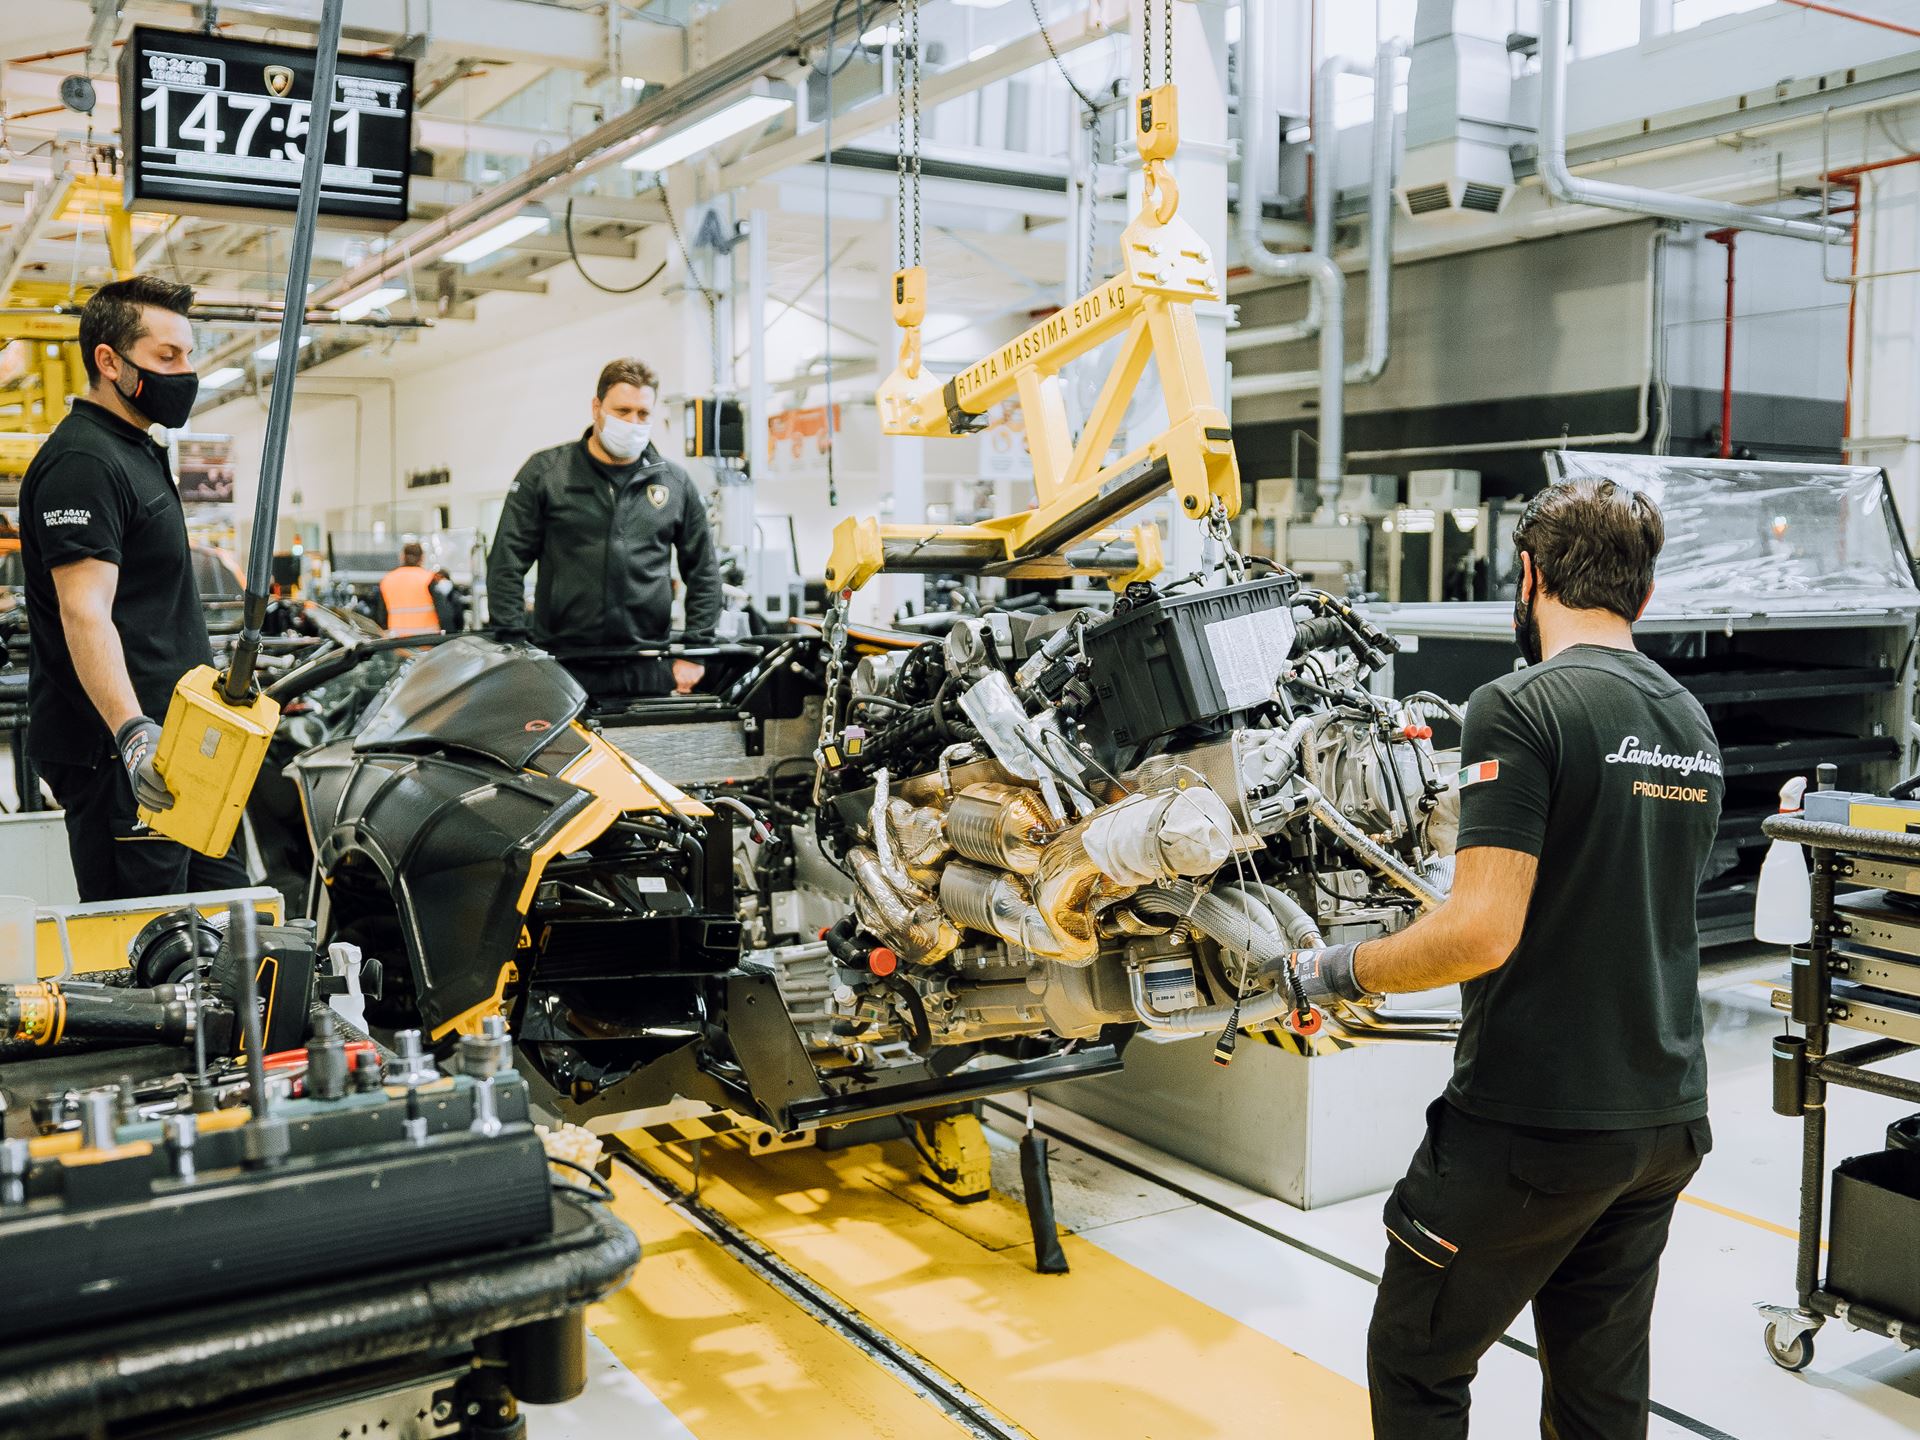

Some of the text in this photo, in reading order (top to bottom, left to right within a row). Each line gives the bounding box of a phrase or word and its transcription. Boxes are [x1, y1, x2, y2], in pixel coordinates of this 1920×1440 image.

[141, 86, 360, 168] 147:51
[1003, 316, 1069, 371] MASSIMA
[1074, 296, 1101, 328] 500
[1107, 286, 1125, 309] kg
[46, 516, 88, 527] BOLOGNESE
[63, 509, 91, 519] AGATA
[1605, 735, 1721, 777] Lamborghini
[1633, 780, 1708, 803] PRODUZIONE
